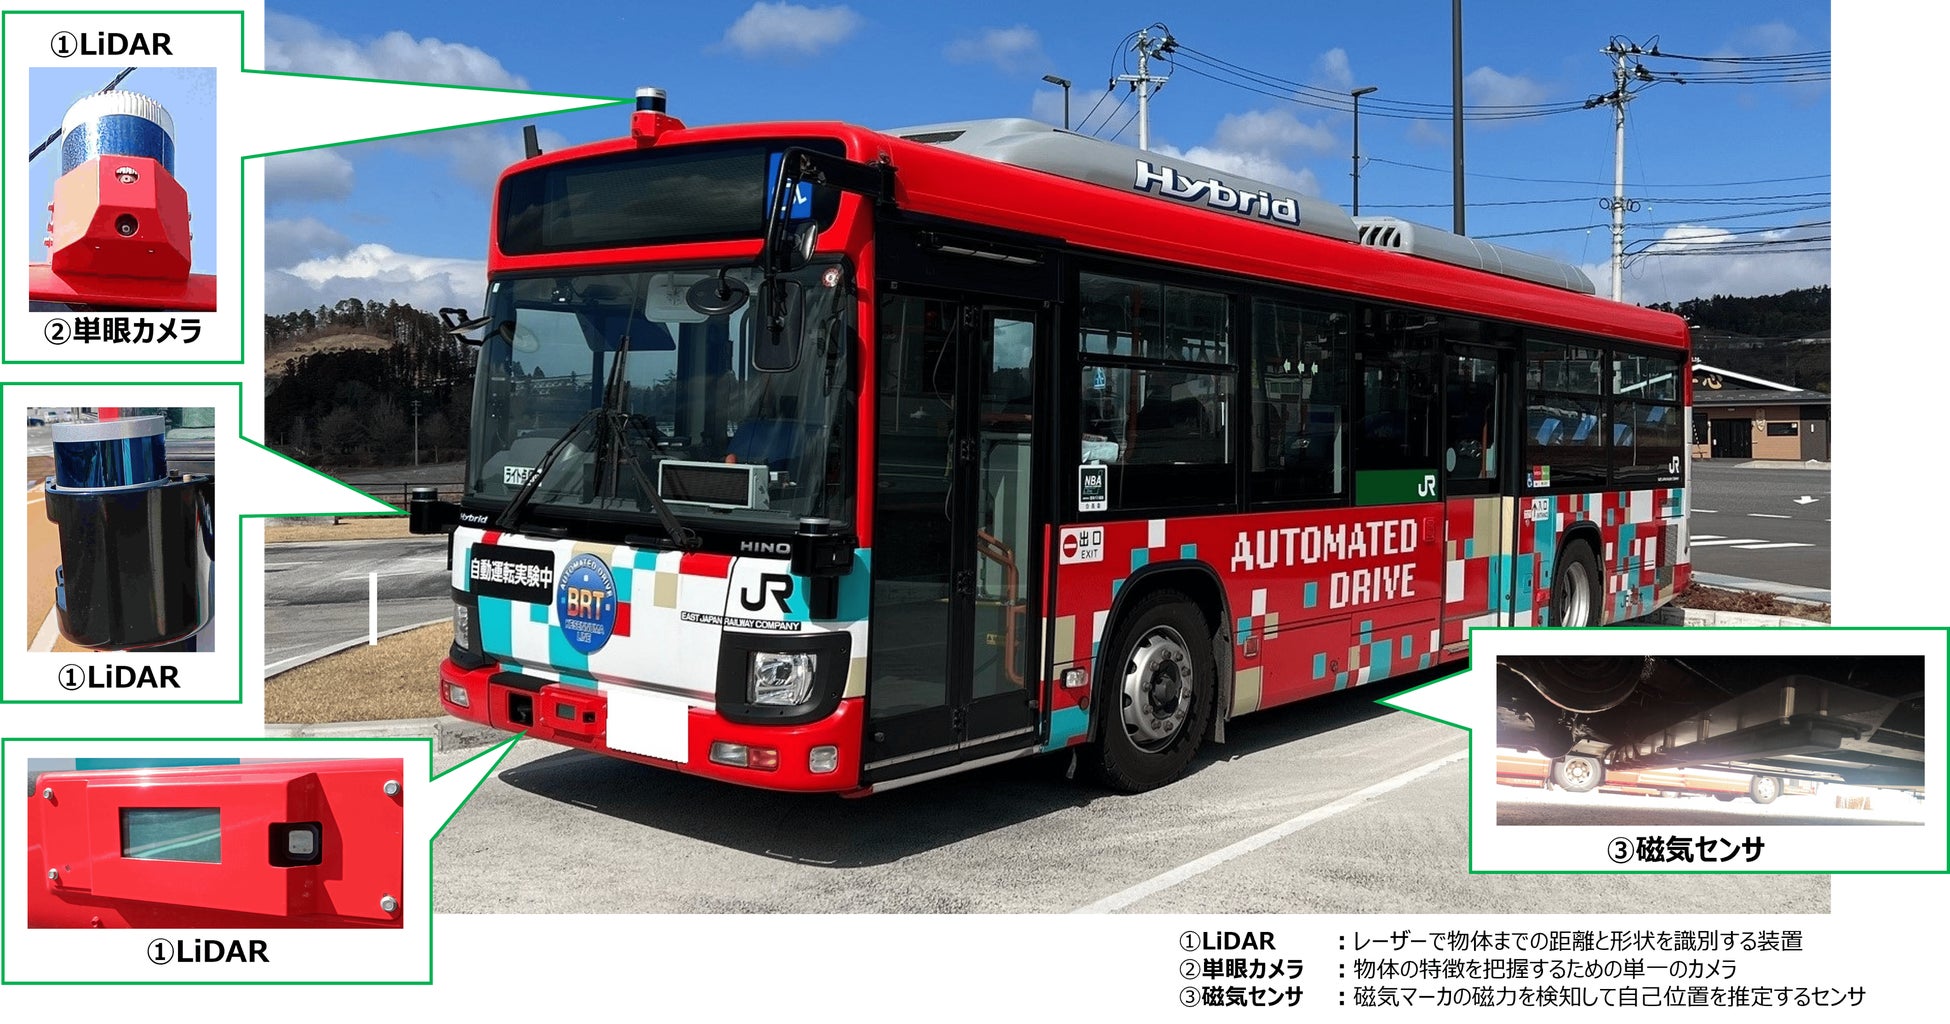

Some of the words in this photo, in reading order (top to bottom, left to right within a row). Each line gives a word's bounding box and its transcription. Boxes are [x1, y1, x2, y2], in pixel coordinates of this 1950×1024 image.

[1134, 159, 1300, 226] Hybrid
[1668, 455, 1680, 474] JR
[1084, 475, 1102, 486] NBA
[1418, 475, 1436, 497] JR
[460, 512, 489, 524] Hybrid
[740, 541, 791, 554] HINO
[1079, 531, 1101, 547] 出口
[1231, 518, 1418, 573] AUTOMATED
[1081, 549, 1099, 560] EXIT
[470, 558, 553, 590] 自動運転実験中
[559, 558, 598, 591] AUTOMATED
[740, 572, 793, 613] JR
[1329, 562, 1417, 610] DRIVE
[567, 587, 605, 621] BRT
[681, 612, 700, 622] EAST
[700, 614, 723, 625] JAPAN
[724, 617, 755, 628] RAILWAY
[755, 620, 800, 631] COMPANY
